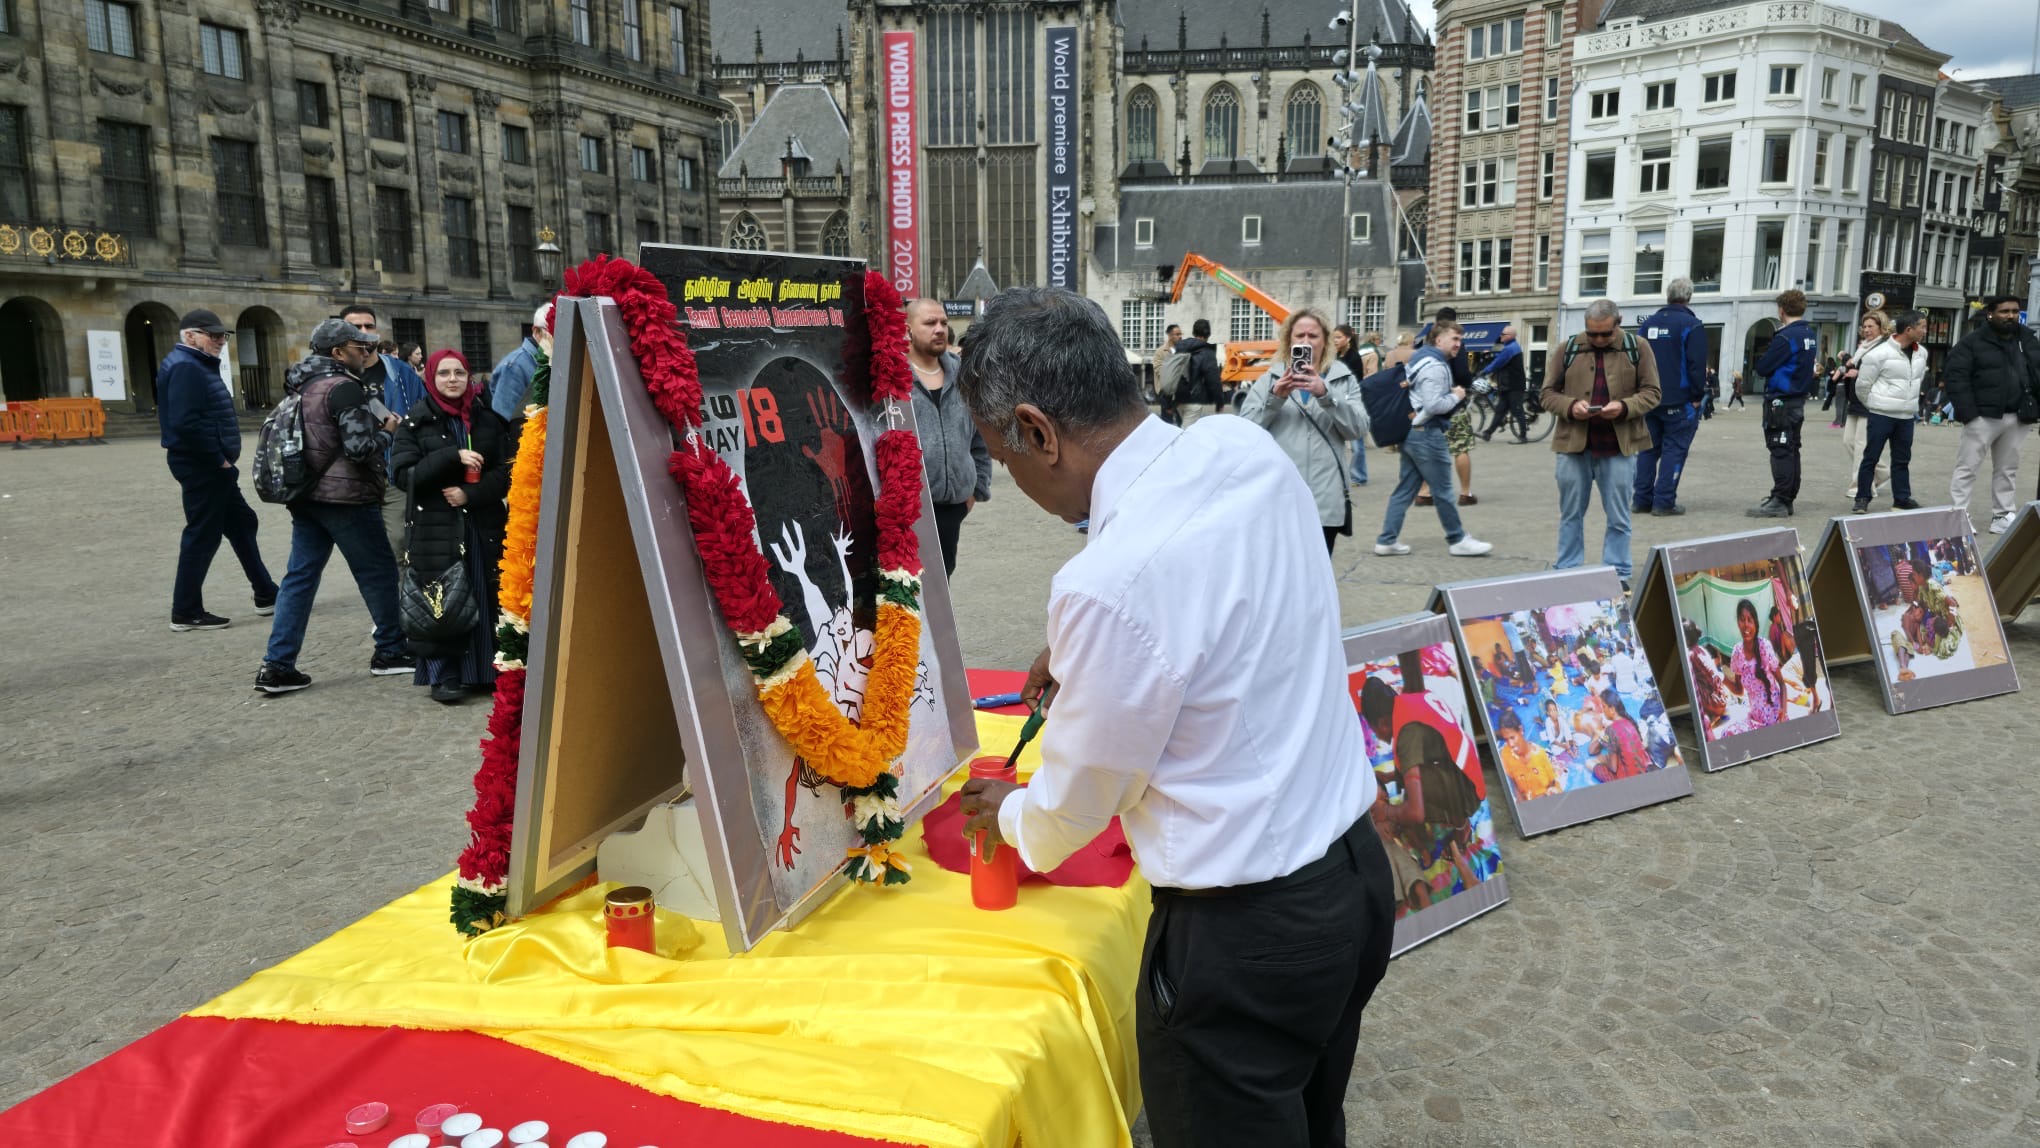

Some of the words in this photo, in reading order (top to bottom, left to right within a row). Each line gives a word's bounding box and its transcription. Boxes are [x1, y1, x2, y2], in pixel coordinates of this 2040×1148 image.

[889, 41, 909, 108] WORLD
[1054, 37, 1070, 89] World
[891, 112, 911, 166] PRESS
[1050, 95, 1070, 174] premiere
[892, 170, 912, 229] PHOTO
[1052, 186, 1071, 287] Exhibition
[684, 275, 731, 303] தமிழின
[737, 278, 773, 303] அழிப்பு
[893, 240, 913, 292] 2026
[684, 306, 720, 329] Tamil
[721, 306, 772, 329] Genocide
[771, 306, 829, 328] Remembrance
[829, 306, 845, 328] Day
[945, 303, 973, 311] Welcome
[97, 364, 117, 372] OPEN
[736, 387, 786, 448] 18
